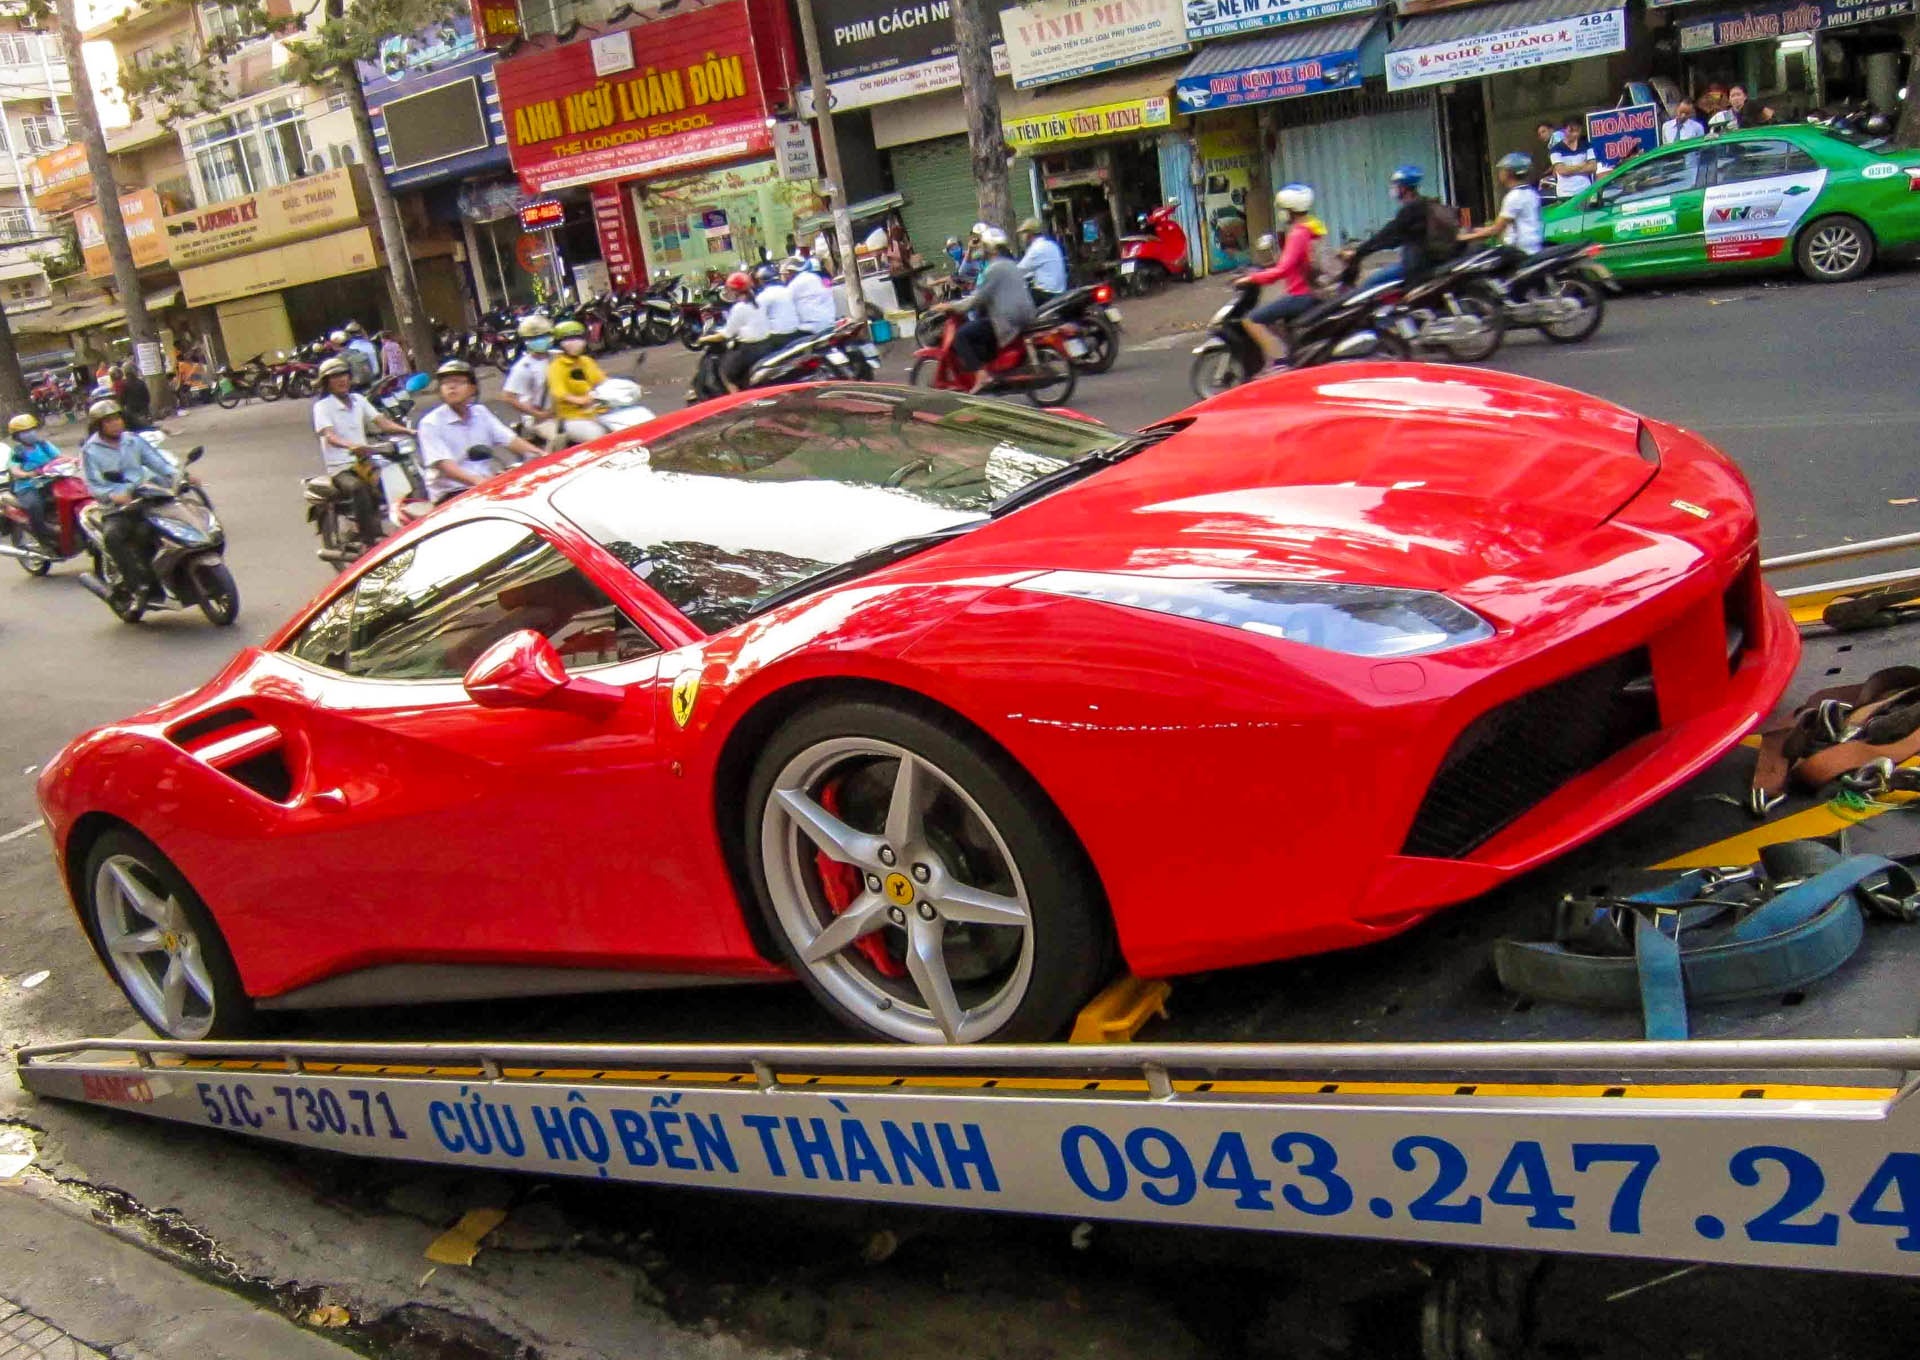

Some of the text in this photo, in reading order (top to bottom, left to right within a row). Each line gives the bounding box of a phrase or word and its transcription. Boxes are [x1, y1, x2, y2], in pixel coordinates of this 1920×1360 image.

[834, 20, 876, 46] PHIM
[879, 8, 929, 34] CÁCH
[1579, 12, 1613, 26] 484
[1719, 12, 1780, 43] HOÀNG
[1490, 33, 1554, 53] QUANG
[515, 50, 747, 146] ANH NGỮ LUÂN ĐÔN
[1210, 76, 1238, 94] MAY
[1275, 67, 1294, 85] XE
[552, 141, 582, 158] THE
[584, 126, 645, 151] LONDON
[648, 114, 713, 137] SCHOOL
[1016, 119, 1041, 143] TIỆM
[1041, 115, 1067, 138] TIỆN
[1105, 108, 1141, 130] MINH
[1590, 111, 1655, 137] HOÀNG
[196, 1083, 407, 1139] 51C-730.71
[428, 1086, 1000, 1192] CỨU HỘ BẾN THÀNH
[1060, 1124, 1920, 1252] 0943.247.24
